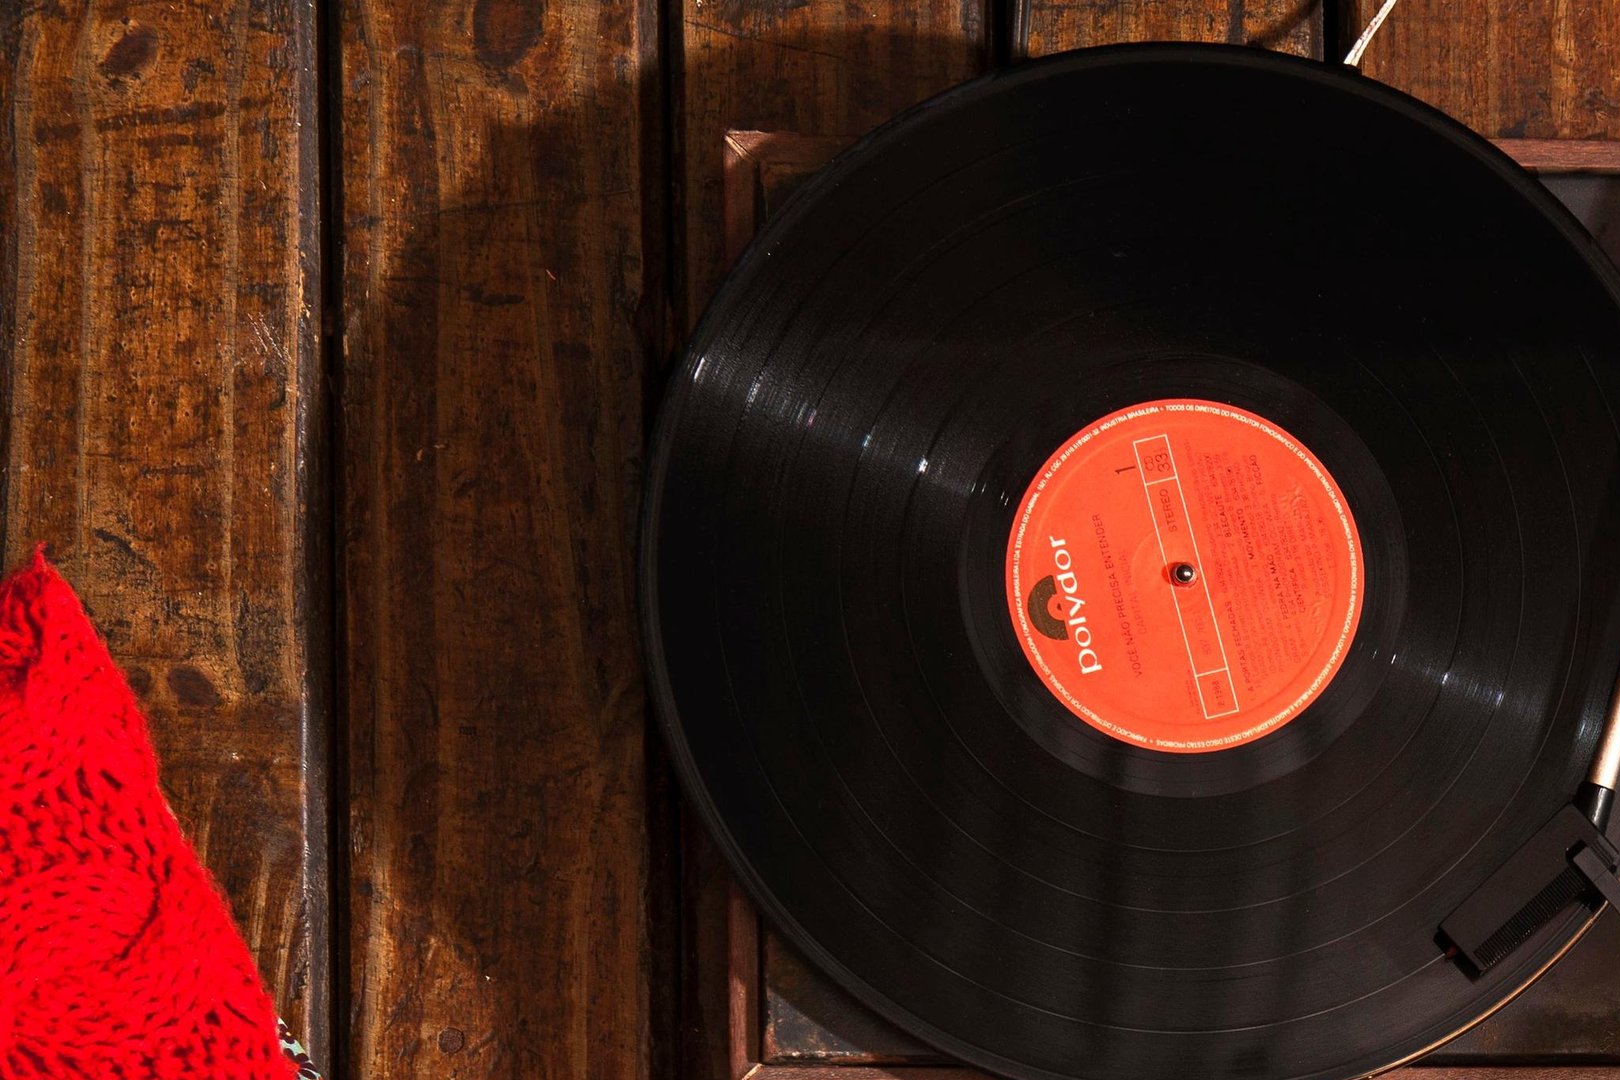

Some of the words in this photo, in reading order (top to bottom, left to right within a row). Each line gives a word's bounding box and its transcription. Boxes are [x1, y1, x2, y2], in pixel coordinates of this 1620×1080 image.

[1114, 464, 1136, 475] 1
[1158, 487, 1177, 533] STEREO
[1236, 507, 1255, 560] MOVIMENTO
[1090, 512, 1114, 570] ENTENDER
